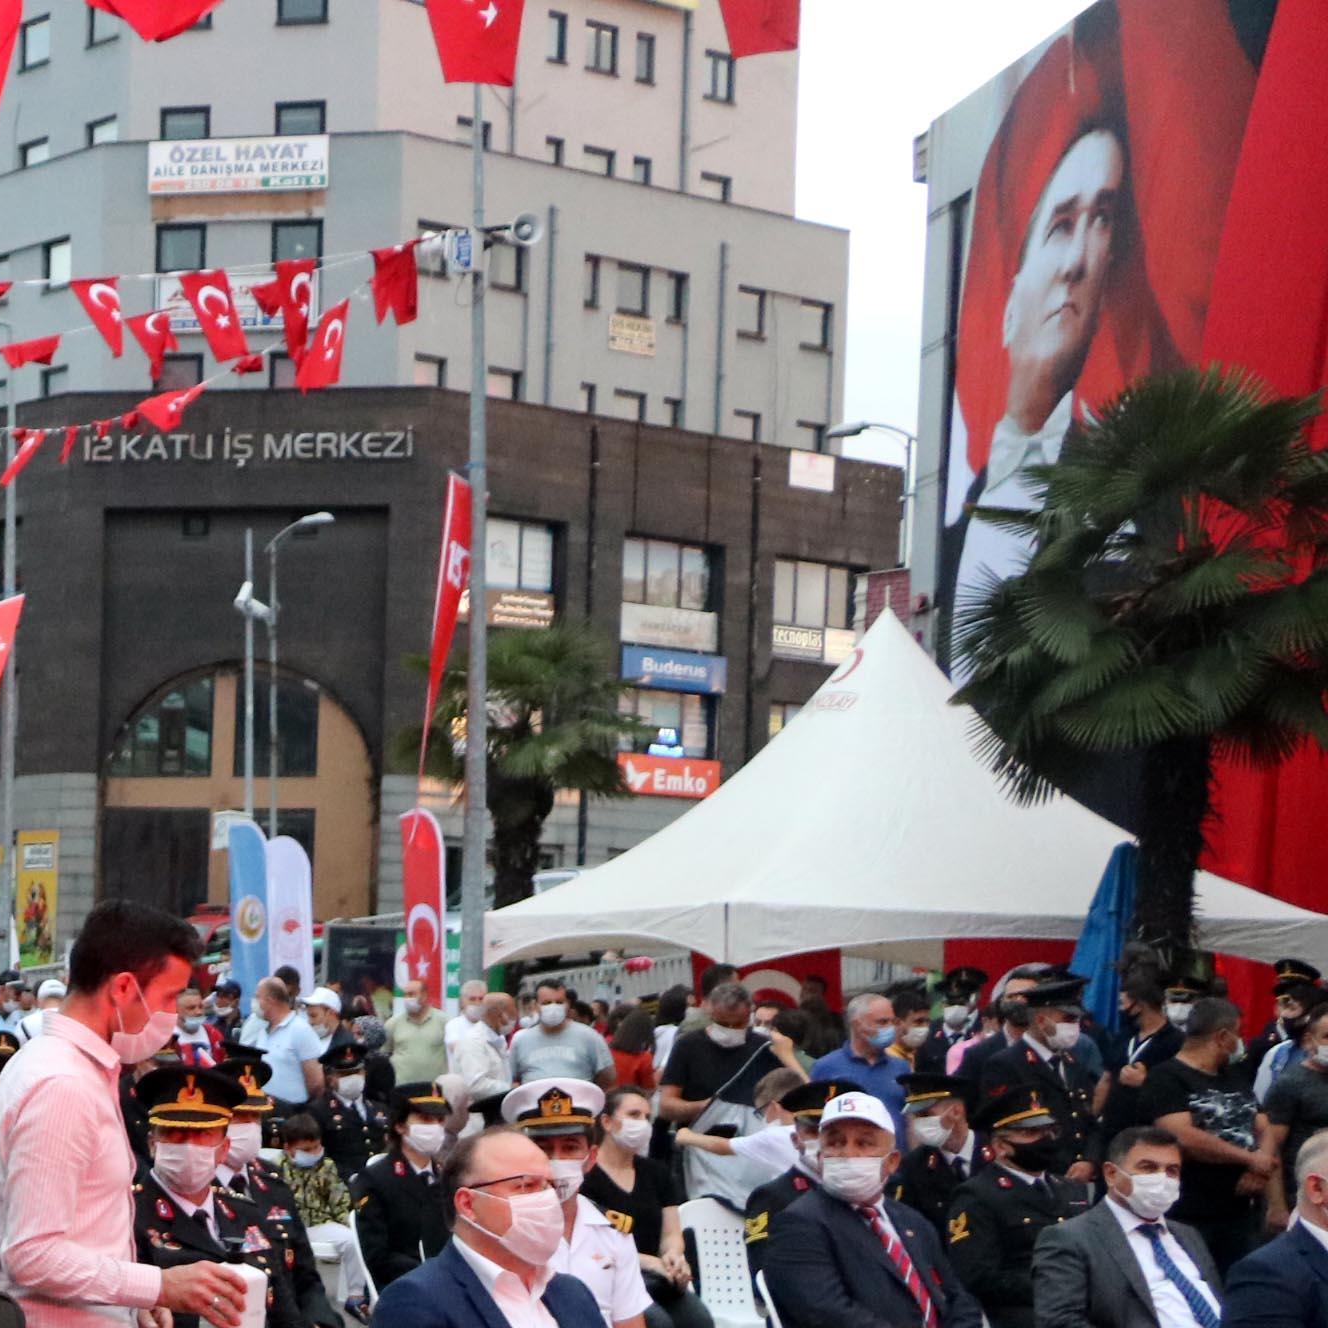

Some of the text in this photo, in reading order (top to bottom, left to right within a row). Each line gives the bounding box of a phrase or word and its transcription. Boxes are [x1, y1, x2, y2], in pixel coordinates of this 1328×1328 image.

[169, 142, 309, 164] ÖZEL HAYAT
[154, 159, 324, 177] AİLE DANIŞMA MERKEZİ
[223, 426, 254, 467] İŞ
[262, 424, 414, 460] MERKEZİ
[641, 656, 708, 678] Buderus
[653, 766, 708, 794] Emko
